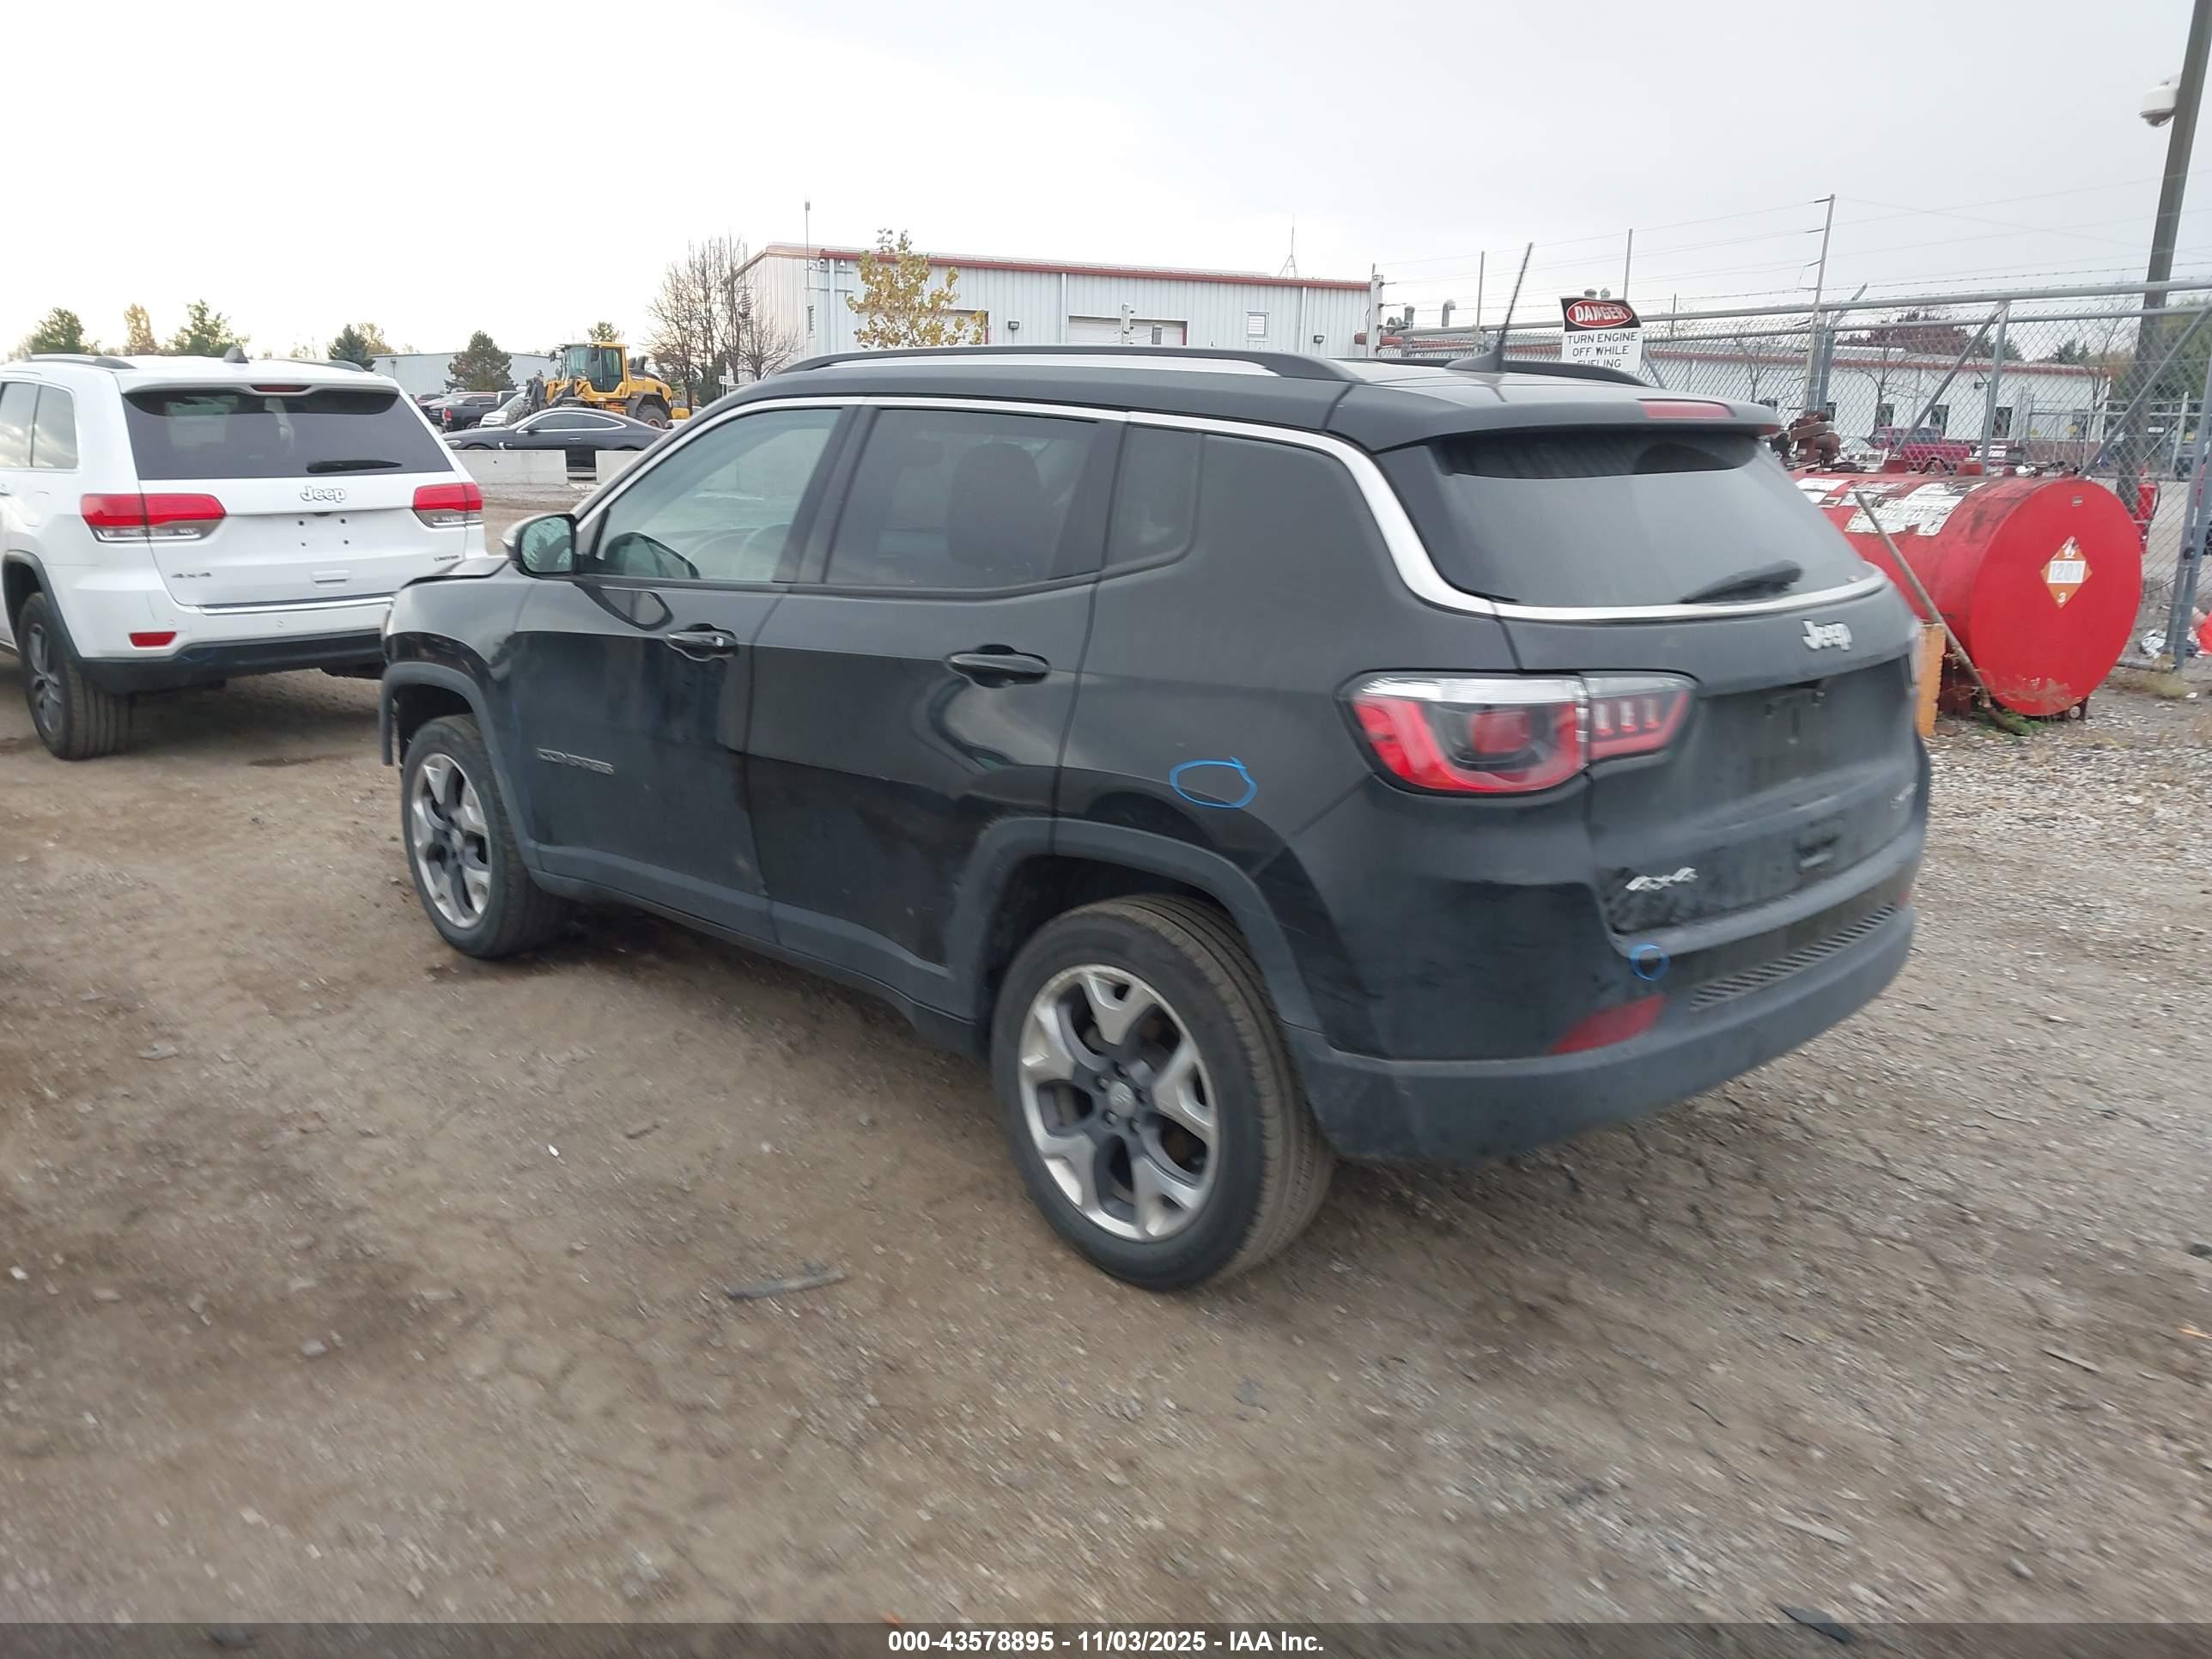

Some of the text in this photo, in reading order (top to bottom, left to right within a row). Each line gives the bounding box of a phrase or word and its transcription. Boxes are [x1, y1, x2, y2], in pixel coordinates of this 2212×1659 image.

[1574, 305, 1627, 322] DANGER
[1567, 331, 1637, 344] TURN ENGINE
[1572, 345, 1629, 357] OFF WHILE
[301, 486, 346, 502] Jeep
[2057, 592, 2066, 603] 3
[1802, 619, 1852, 651] Jeep
